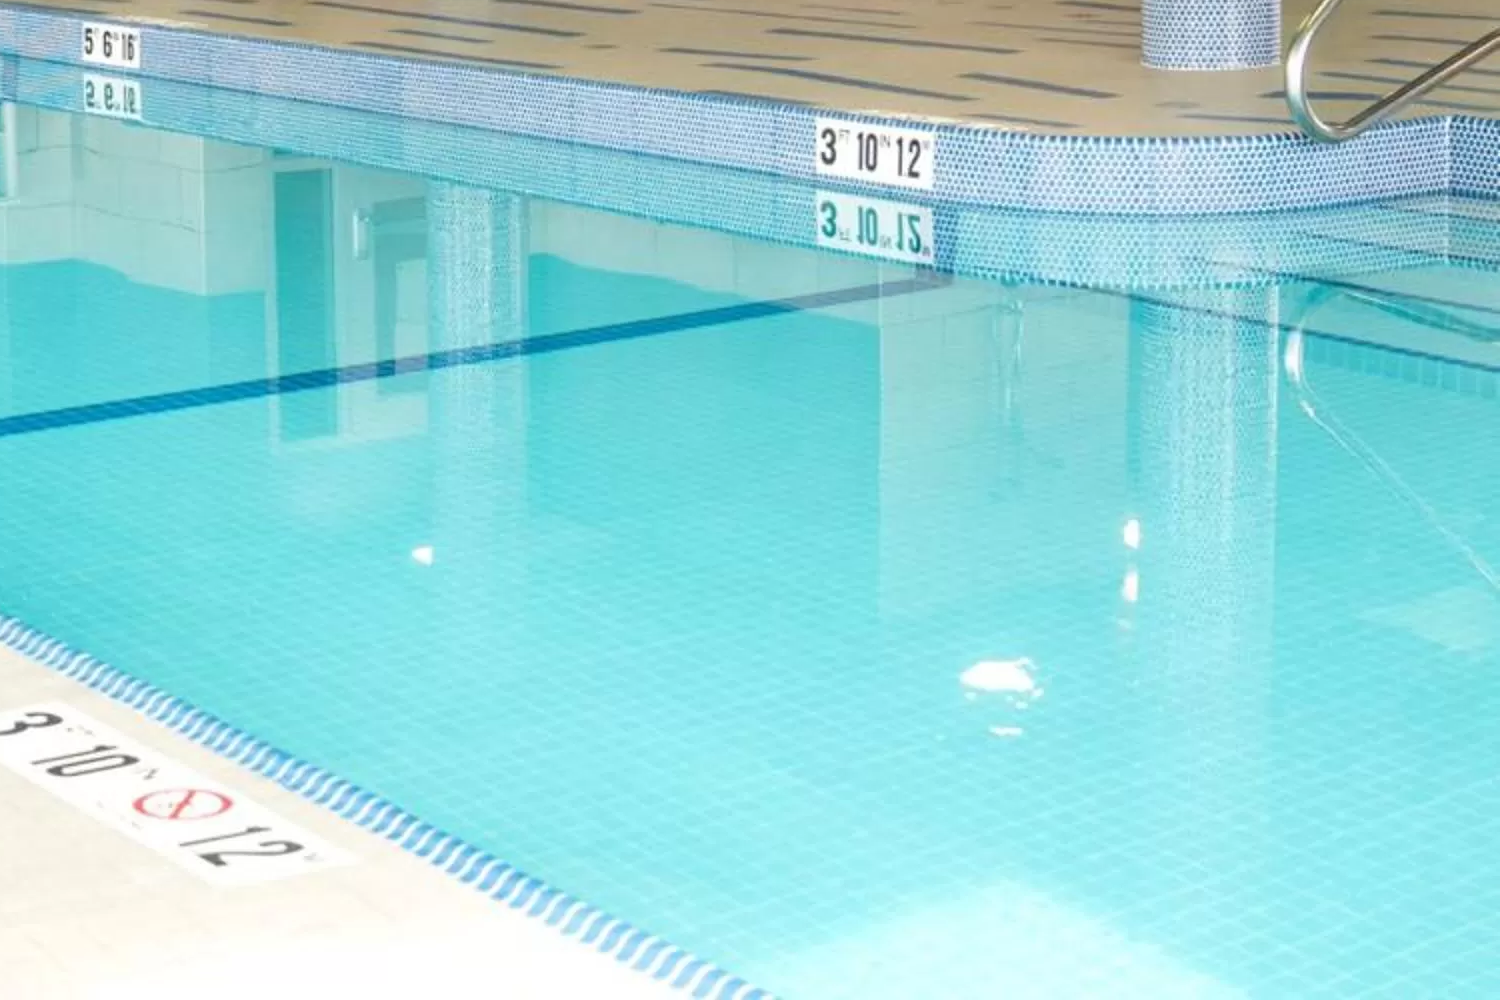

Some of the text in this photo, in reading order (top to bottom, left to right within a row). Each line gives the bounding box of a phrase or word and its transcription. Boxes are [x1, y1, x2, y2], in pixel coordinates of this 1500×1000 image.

[84, 27, 94, 55] 5
[103, 30, 113, 59] 6
[820, 127, 837, 165] 3
[856, 131, 878, 172] 10
[30, 745, 141, 777] 10
